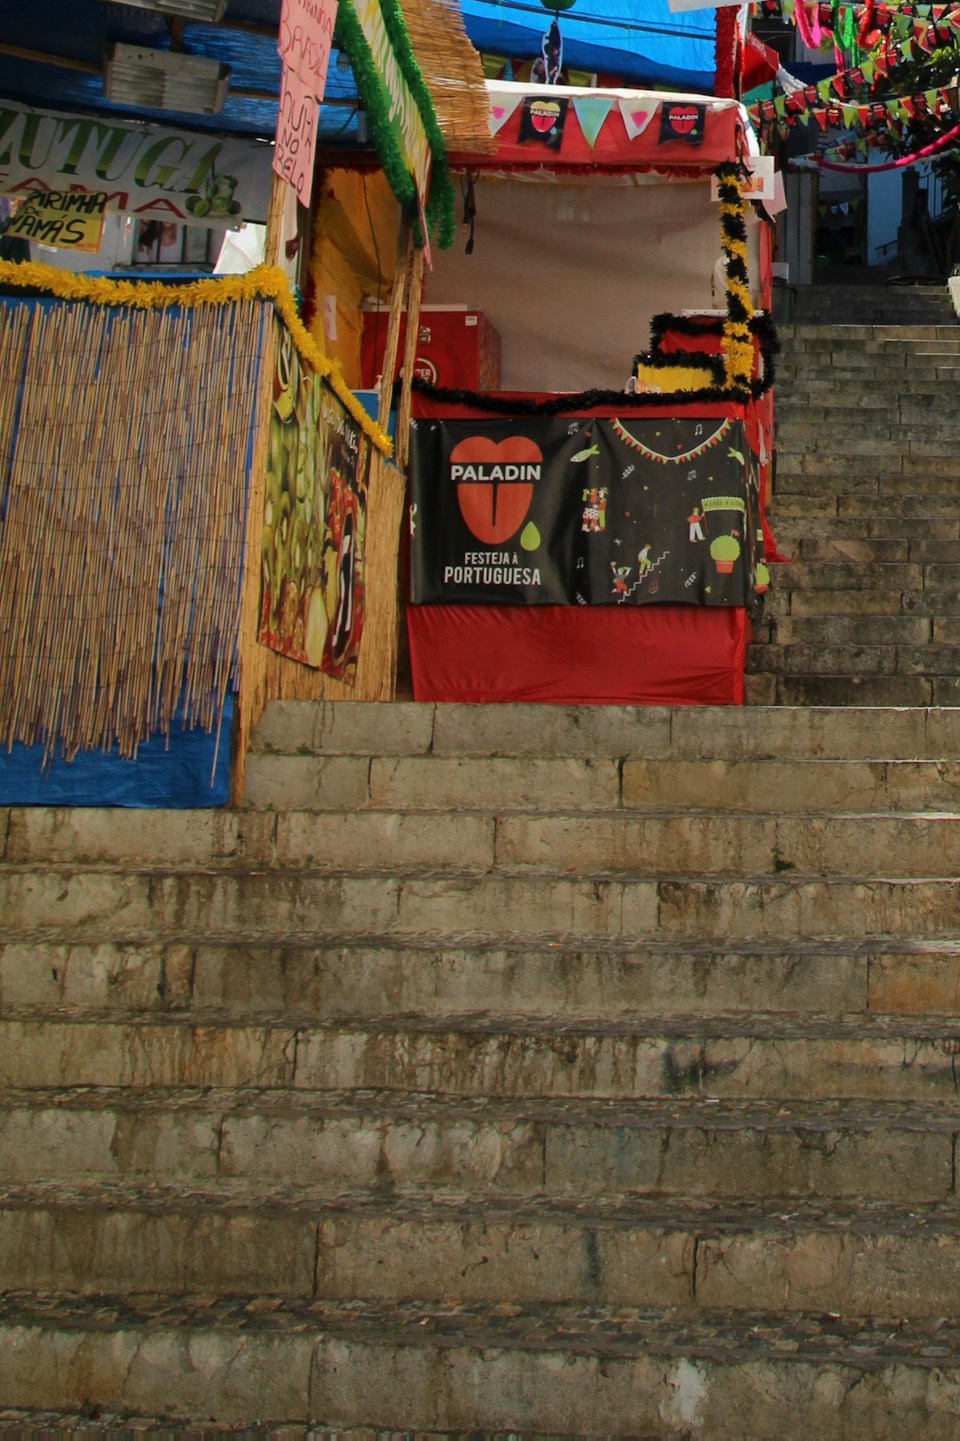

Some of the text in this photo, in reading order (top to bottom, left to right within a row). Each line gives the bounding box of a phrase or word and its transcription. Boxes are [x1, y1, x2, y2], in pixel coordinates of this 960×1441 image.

[450, 464, 542, 482] PALADIN
[464, 552, 510, 565] FESTEJA
[444, 566, 541, 586] PORTUGUESA
